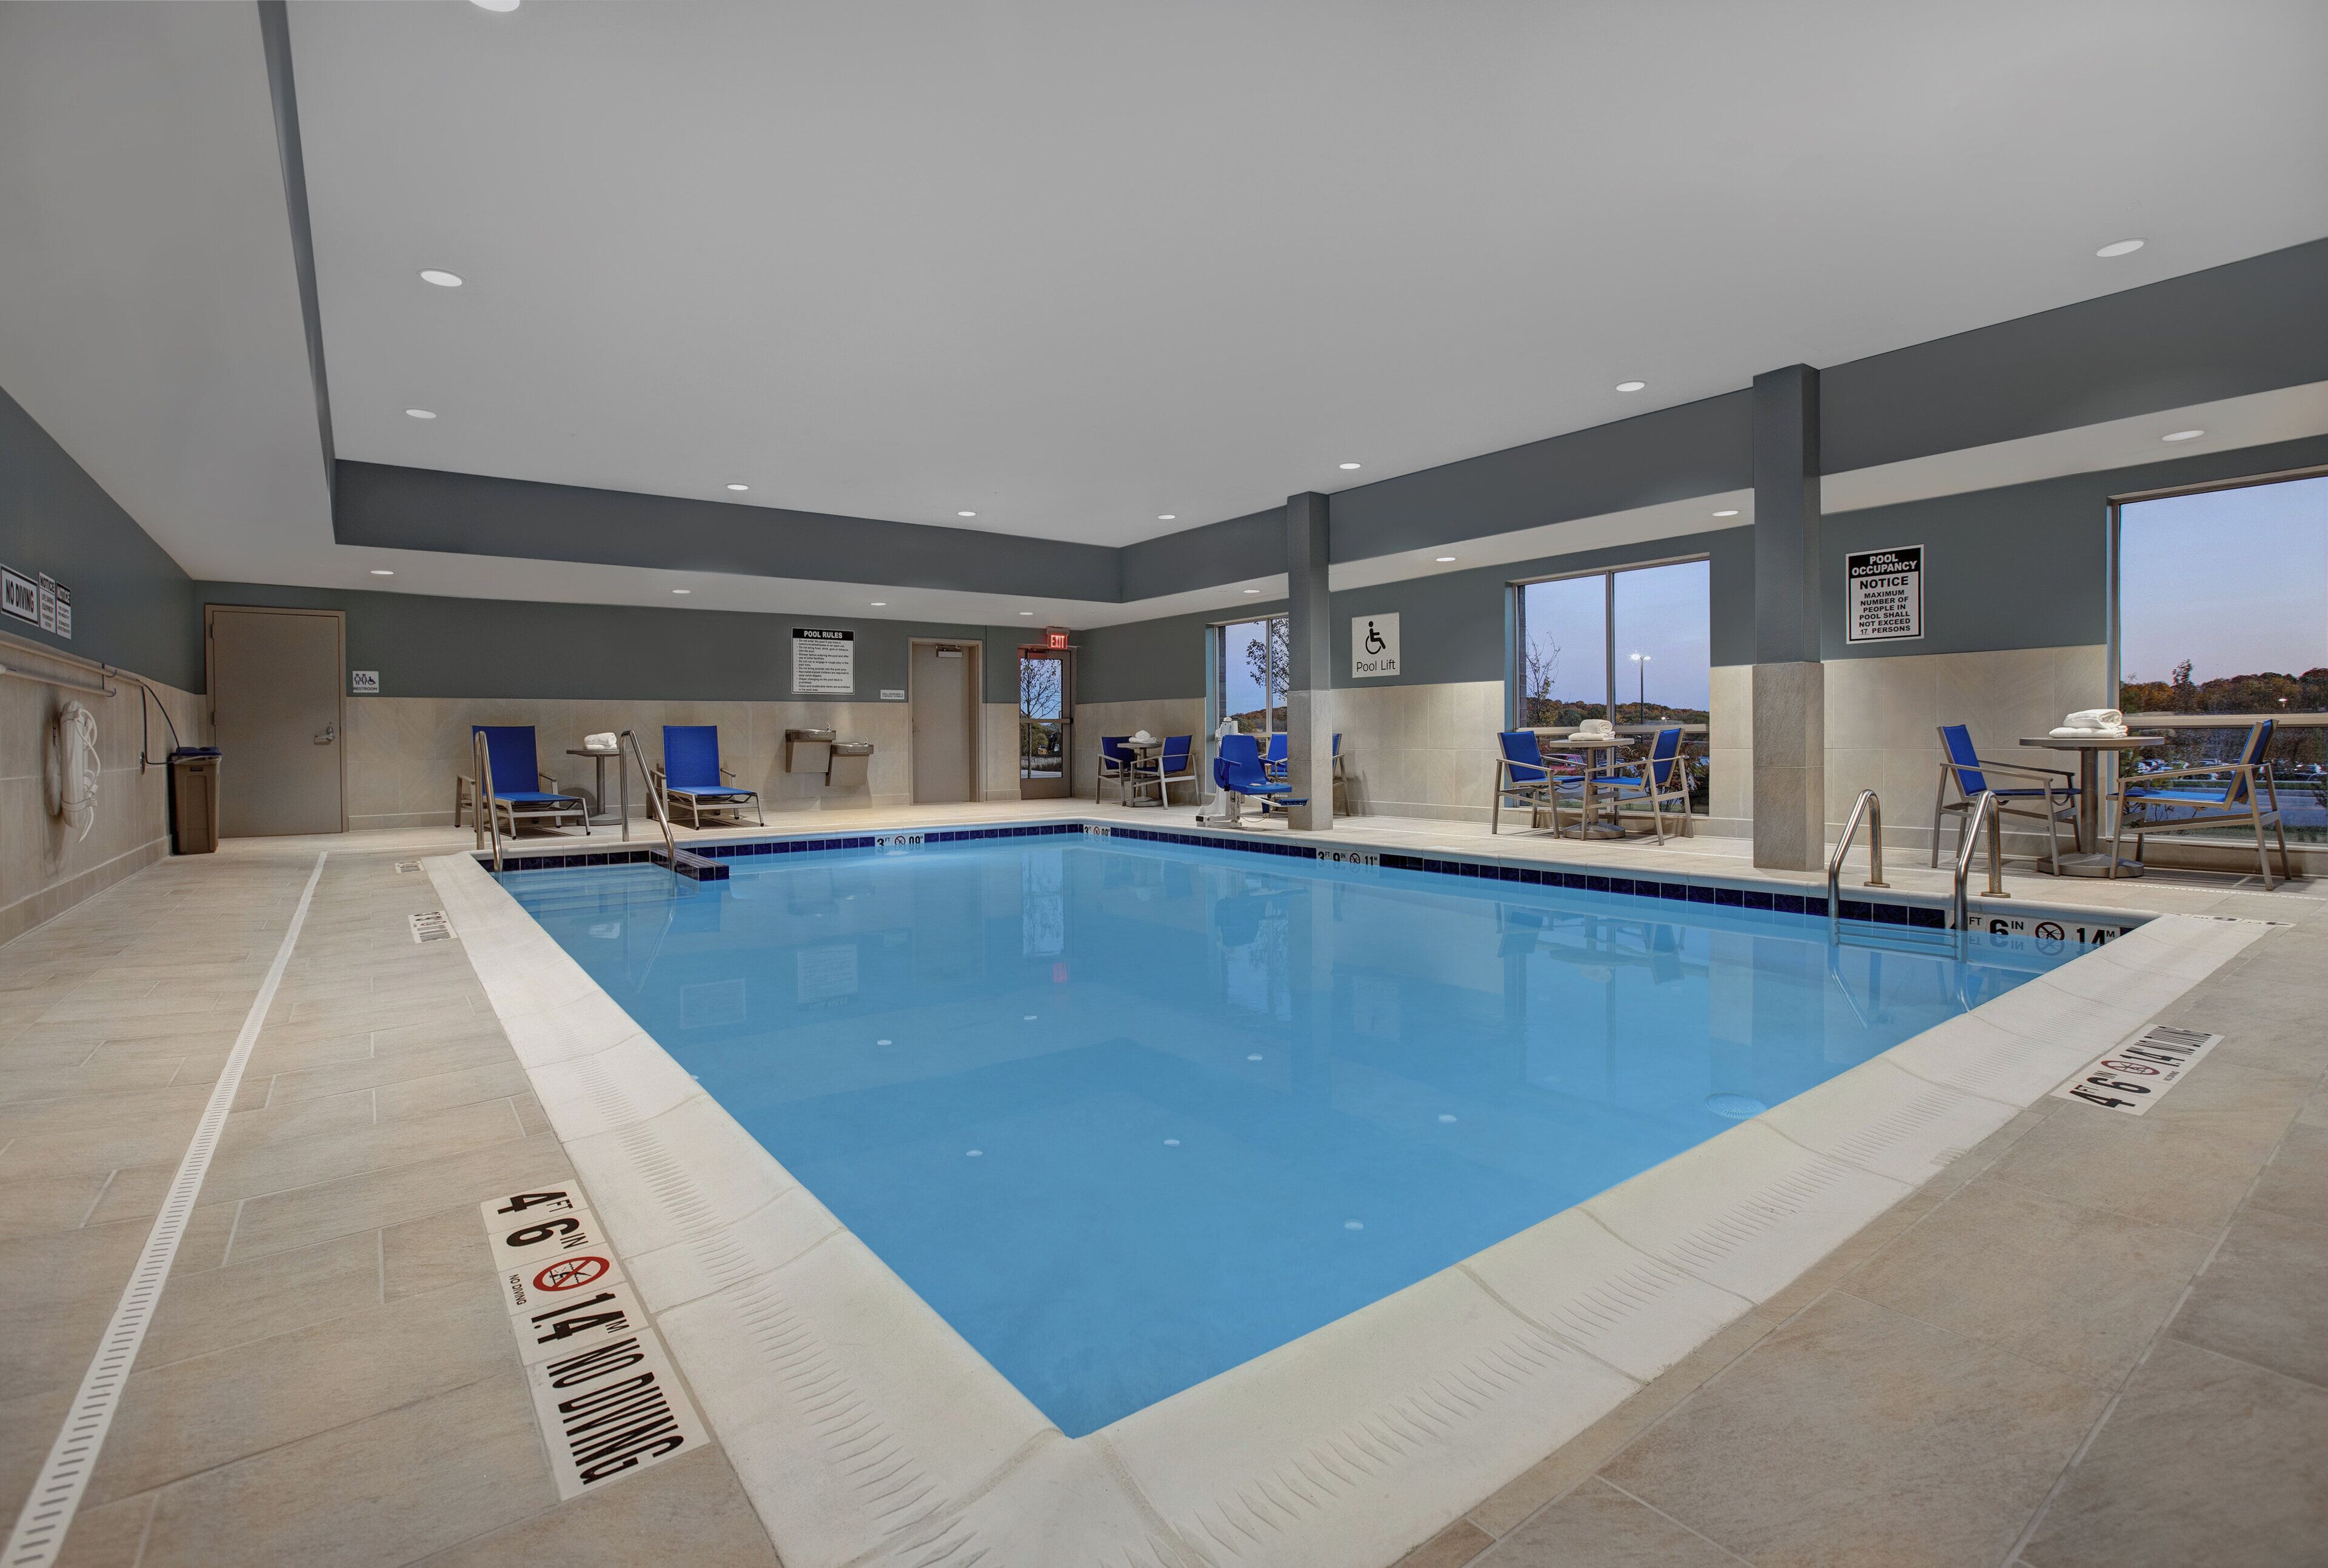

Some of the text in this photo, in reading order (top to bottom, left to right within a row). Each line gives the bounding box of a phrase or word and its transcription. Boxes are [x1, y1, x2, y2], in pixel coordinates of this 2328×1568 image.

[1870, 553, 1898, 564] POOL
[1851, 561, 1917, 576] OCCUPANCY
[40, 576, 55, 593] NOTICE
[1860, 576, 1908, 590] NOTICE
[6, 578, 34, 614] NO DIVING
[57, 585, 70, 604] NOTICE
[1864, 590, 1905, 599] MAXIMUM
[1051, 635, 1065, 648] EXIT
[1357, 659, 1396, 672] Pool Lift
[509, 1274, 527, 1306] NO DIVING
[546, 1336, 645, 1389] NO
[558, 1372, 684, 1486] DIVING
